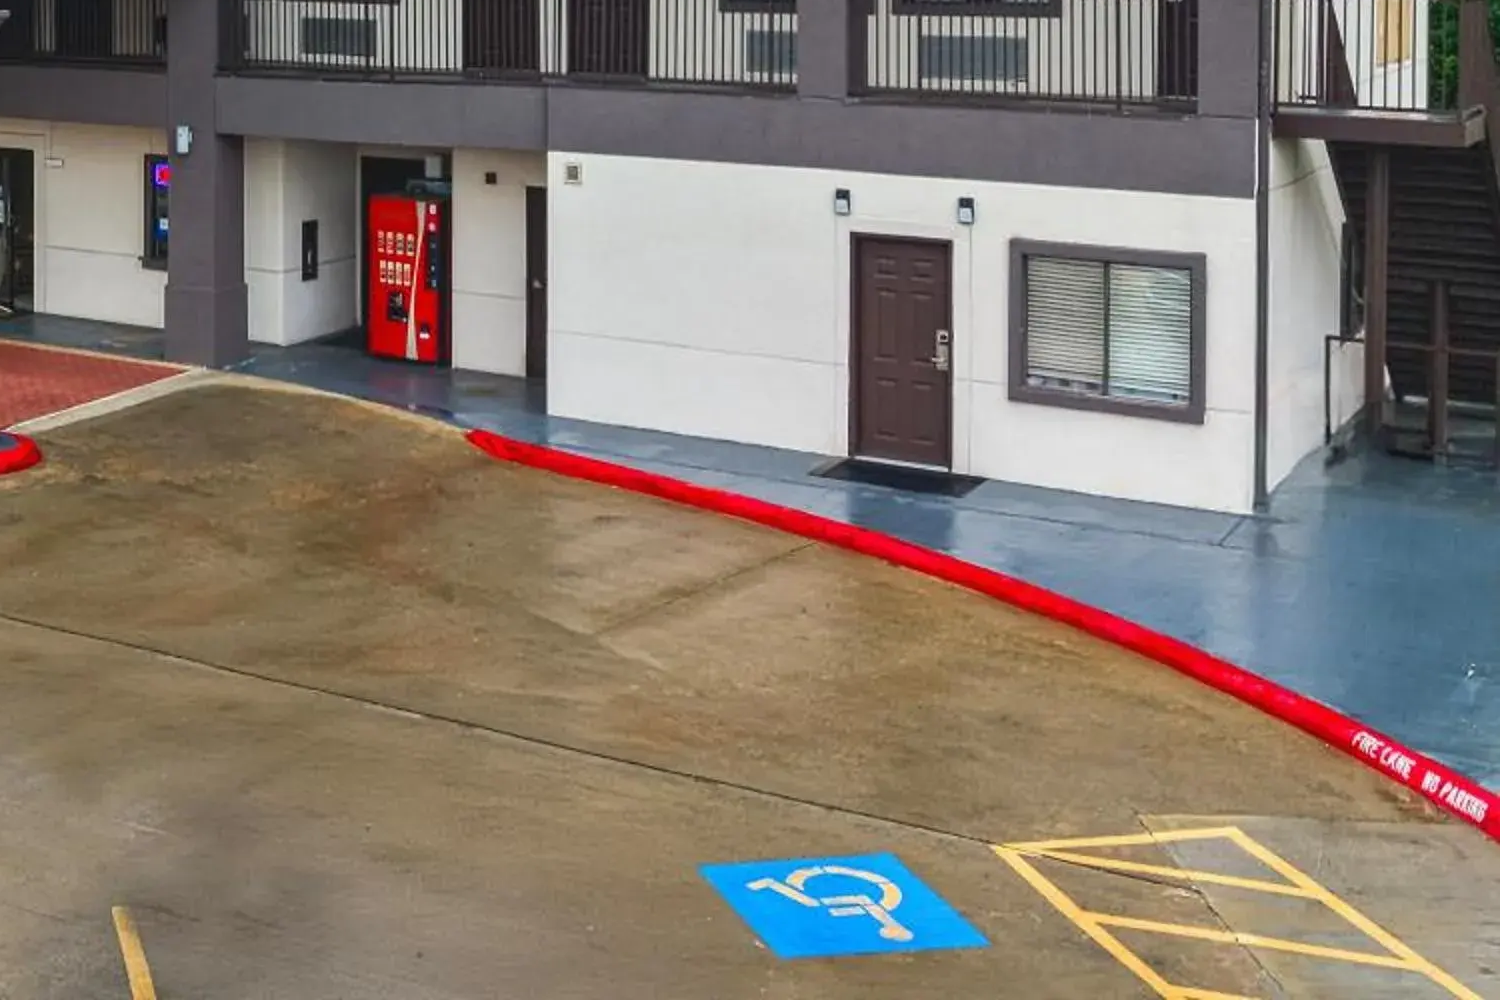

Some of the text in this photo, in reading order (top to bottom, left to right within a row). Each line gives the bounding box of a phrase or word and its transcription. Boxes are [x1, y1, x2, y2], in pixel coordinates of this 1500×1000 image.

[1352, 731, 1489, 823] FIRE LANE NO PARKING
